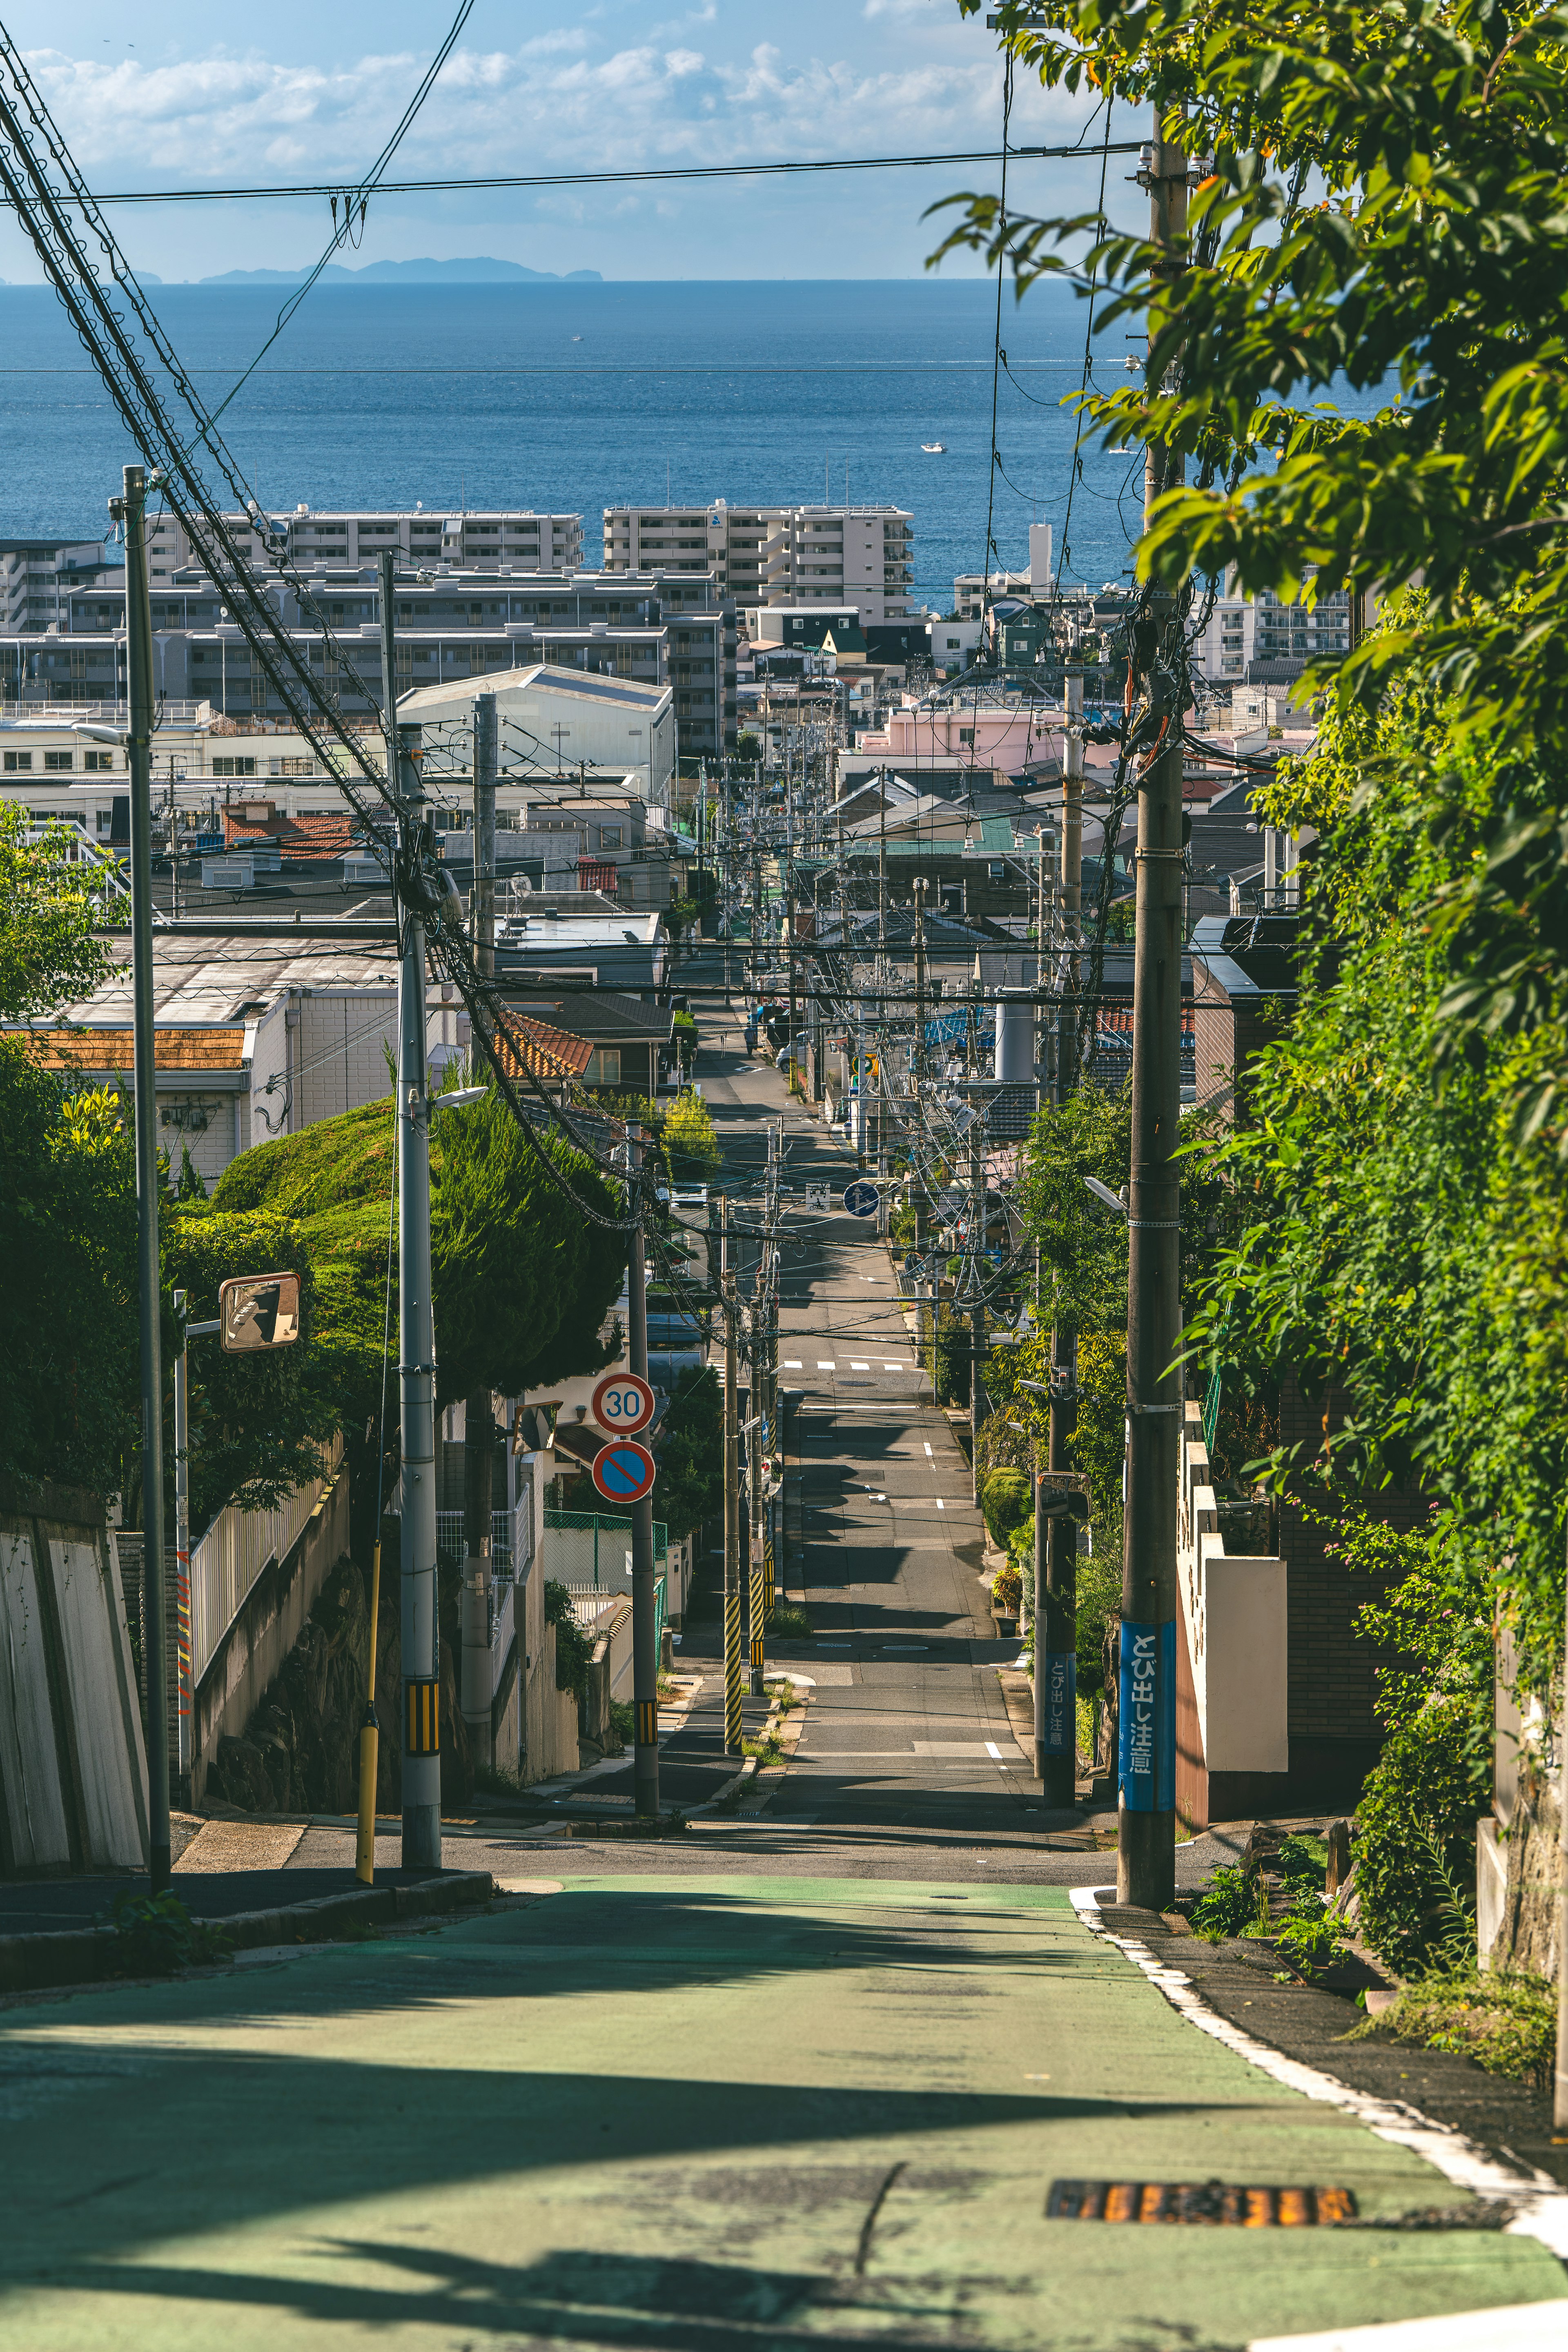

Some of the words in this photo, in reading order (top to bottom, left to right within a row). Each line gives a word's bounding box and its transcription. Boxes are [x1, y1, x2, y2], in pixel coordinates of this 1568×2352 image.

[606, 1391, 639, 1417] 30
[1049, 1662, 1065, 1746] とび出し注意
[1129, 1635, 1157, 1774] とび出し注意
